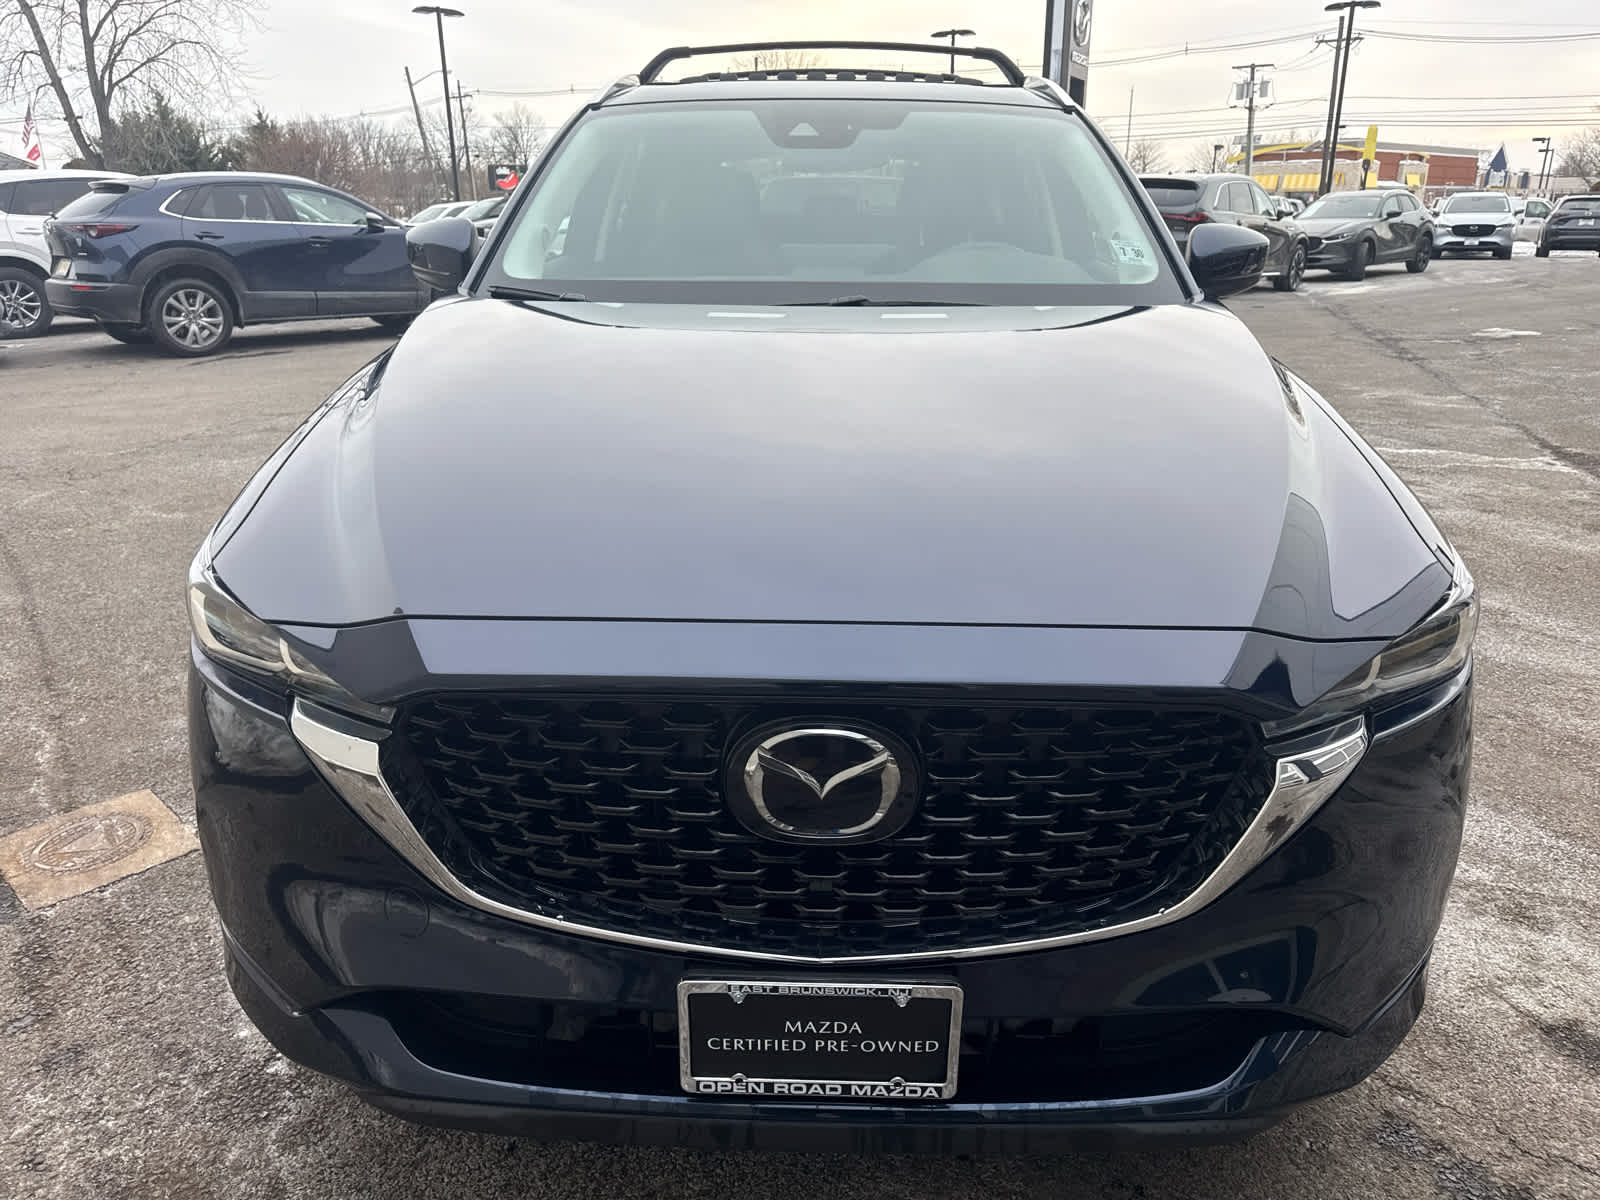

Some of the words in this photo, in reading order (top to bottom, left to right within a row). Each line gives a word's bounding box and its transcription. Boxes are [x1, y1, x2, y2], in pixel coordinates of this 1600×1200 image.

[730, 984, 772, 994] EAST
[887, 988, 910, 997] NJ
[784, 1021, 863, 1035] MAZDA
[707, 1037, 807, 1052] CERTIFIED
[815, 1039, 940, 1053] PRE-OWNED
[699, 1081, 765, 1093] OPEN
[773, 1083, 843, 1096] ROAD
[850, 1084, 940, 1098] MAZDA
